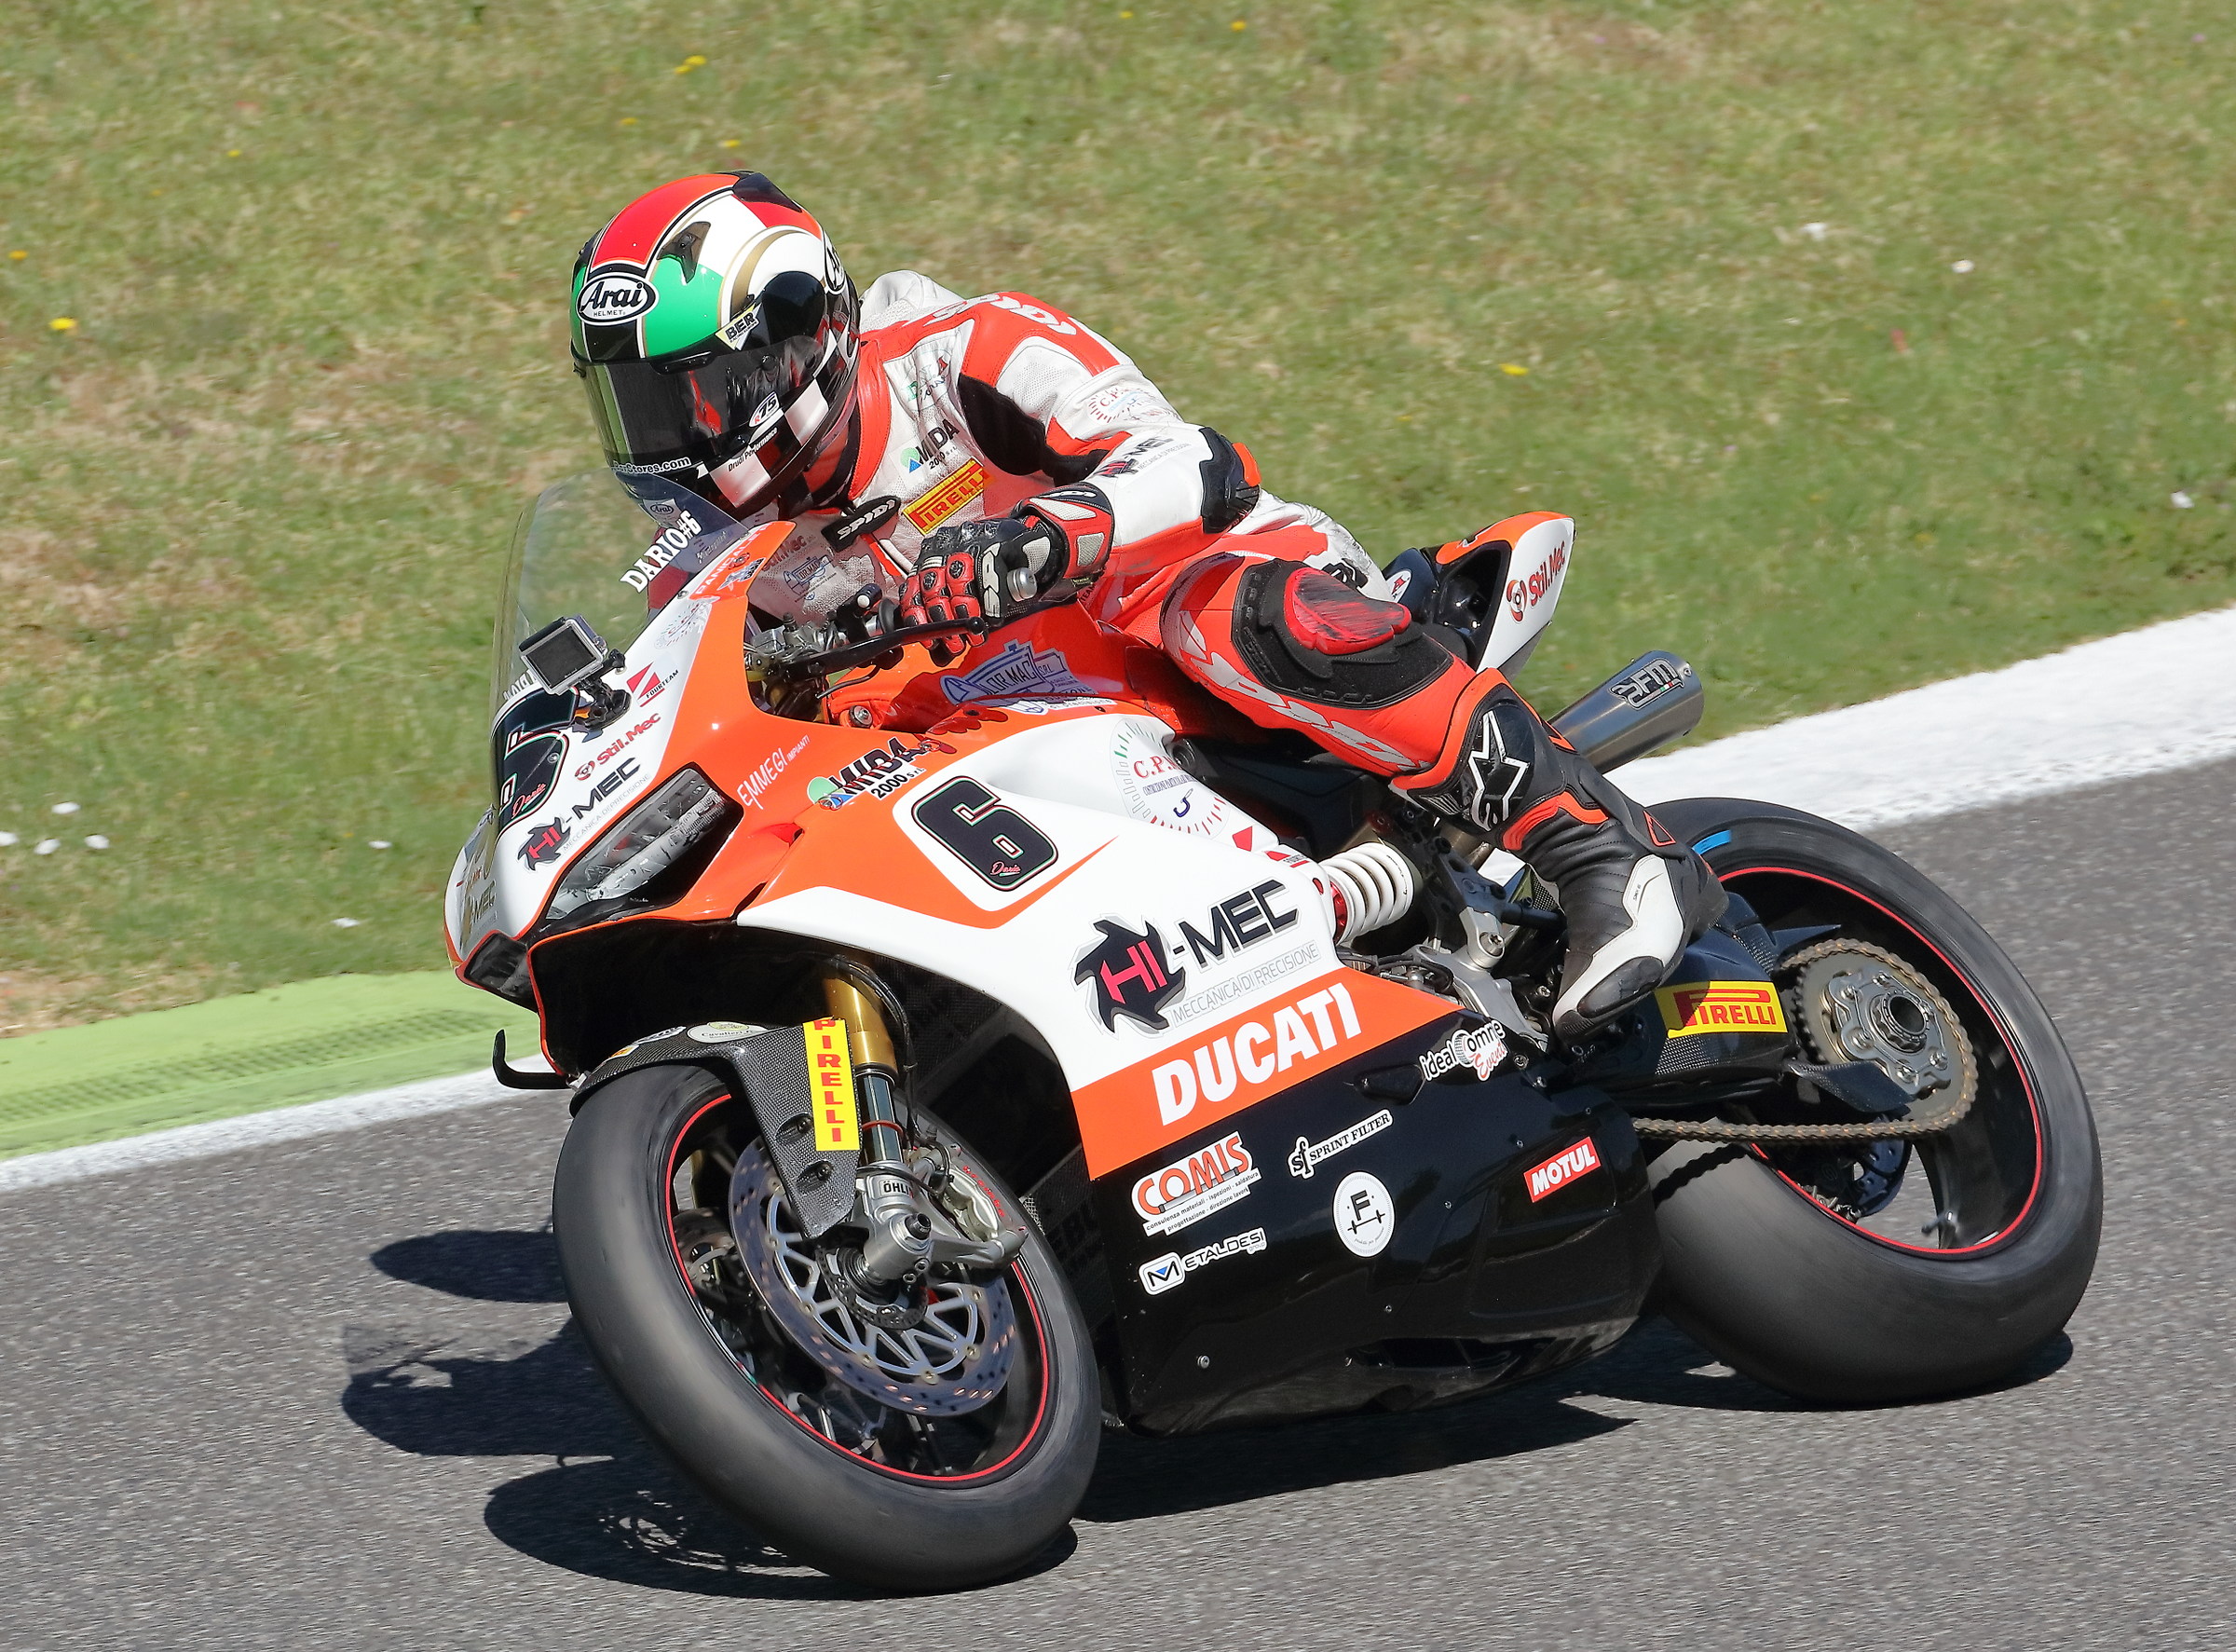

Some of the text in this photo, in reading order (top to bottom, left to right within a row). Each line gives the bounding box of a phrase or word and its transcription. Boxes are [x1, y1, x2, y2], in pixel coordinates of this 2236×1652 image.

[580, 281, 644, 310] Arai
[593, 309, 623, 318] HELMET
[725, 312, 756, 340] BER
[837, 498, 896, 540] SPIDI
[908, 463, 991, 528] PIRELLI
[620, 510, 702, 594] DARIO#6
[1527, 539, 1567, 608] Stil.Mec
[646, 669, 679, 699] FOURTEAM
[596, 712, 661, 766] Stil.Mec
[736, 748, 789, 809] EMMEGI
[870, 771, 907, 799] 2000
[911, 775, 1059, 892] 6
[1099, 880, 1299, 1004] HI-MEC
[1173, 981, 1243, 1024] MECCANICA
[1255, 943, 1319, 988] PRECISIONE
[1673, 989, 1777, 1027] PIRELLI
[813, 1018, 844, 1142] PIRELLI
[1152, 983, 1362, 1126] DUCATI
[1419, 1044, 1459, 1077] ideal
[1308, 1134, 1350, 1161] SPRINT
[1349, 1113, 1390, 1140] FILTER
[1138, 1135, 1249, 1215] COMIS
[1531, 1143, 1596, 1197] MOTUL
[1145, 1169, 1258, 1231] consulenza materiali ispezioni saldatura
[1166, 1208, 1206, 1232] progettazione
[1208, 1195, 1233, 1210] direzione
[1350, 1190, 1370, 1222] F
